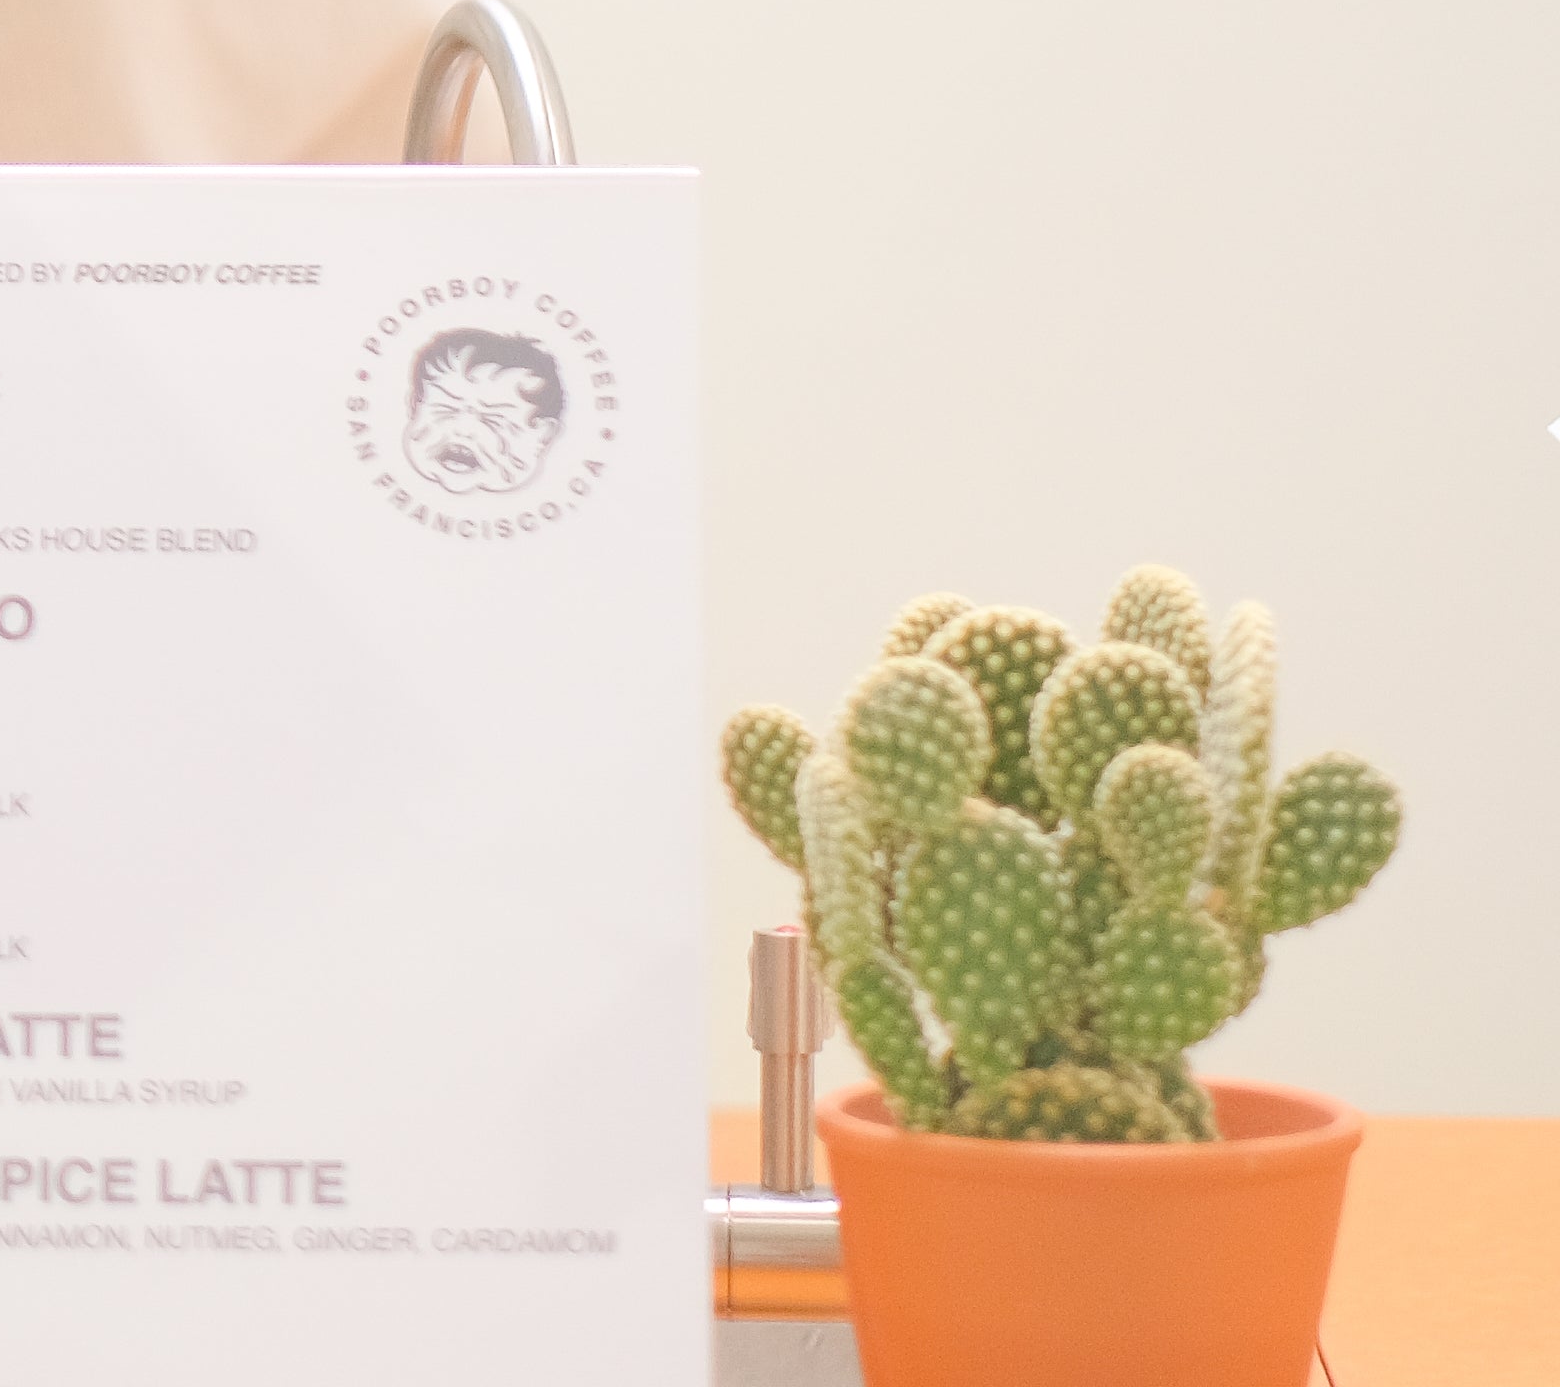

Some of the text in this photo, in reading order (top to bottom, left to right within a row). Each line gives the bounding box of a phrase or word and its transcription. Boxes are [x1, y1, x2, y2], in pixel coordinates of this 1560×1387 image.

[31, 261, 65, 285] BY
[74, 262, 209, 285] POORBOY
[214, 263, 322, 286] COFFEE
[360, 276, 619, 411] POORBOY COFFEE
[345, 395, 377, 463] SAN
[40, 526, 148, 554] HOUSE
[156, 527, 258, 554] BLEND
[9, 1079, 134, 1106] VANILLA
[139, 1078, 247, 1107] SYRUP
[158, 1159, 347, 1207] LATTE
